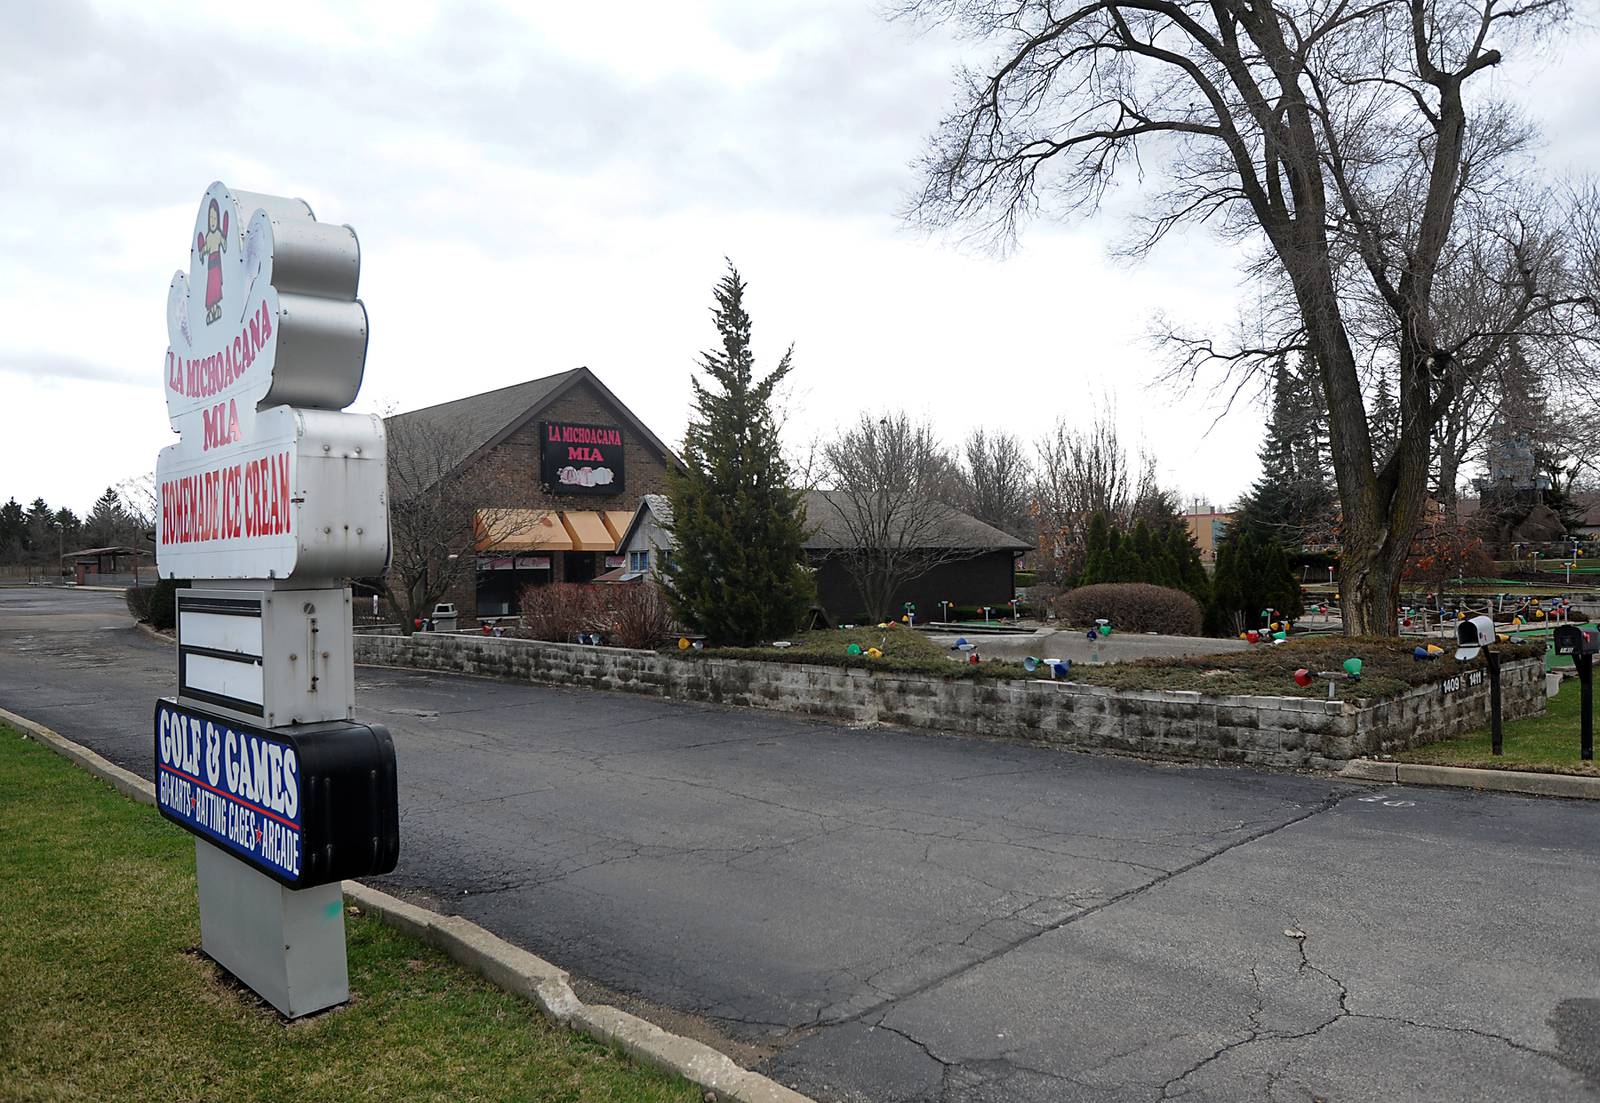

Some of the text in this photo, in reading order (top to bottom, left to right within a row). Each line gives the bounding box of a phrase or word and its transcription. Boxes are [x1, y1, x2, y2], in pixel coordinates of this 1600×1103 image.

[169, 299, 272, 397] LA MICHOACANA
[203, 399, 241, 451] MIA
[549, 425, 621, 445] LA MICHOACANA
[568, 447, 604, 461] MIA
[162, 451, 291, 546] HOMEMADE ICE CREAM
[1444, 677, 1459, 693] 1409
[160, 708, 298, 819] GOLF & GAMES
[160, 771, 300, 876] GO-KARTS BATTING CAGES ARCADE
